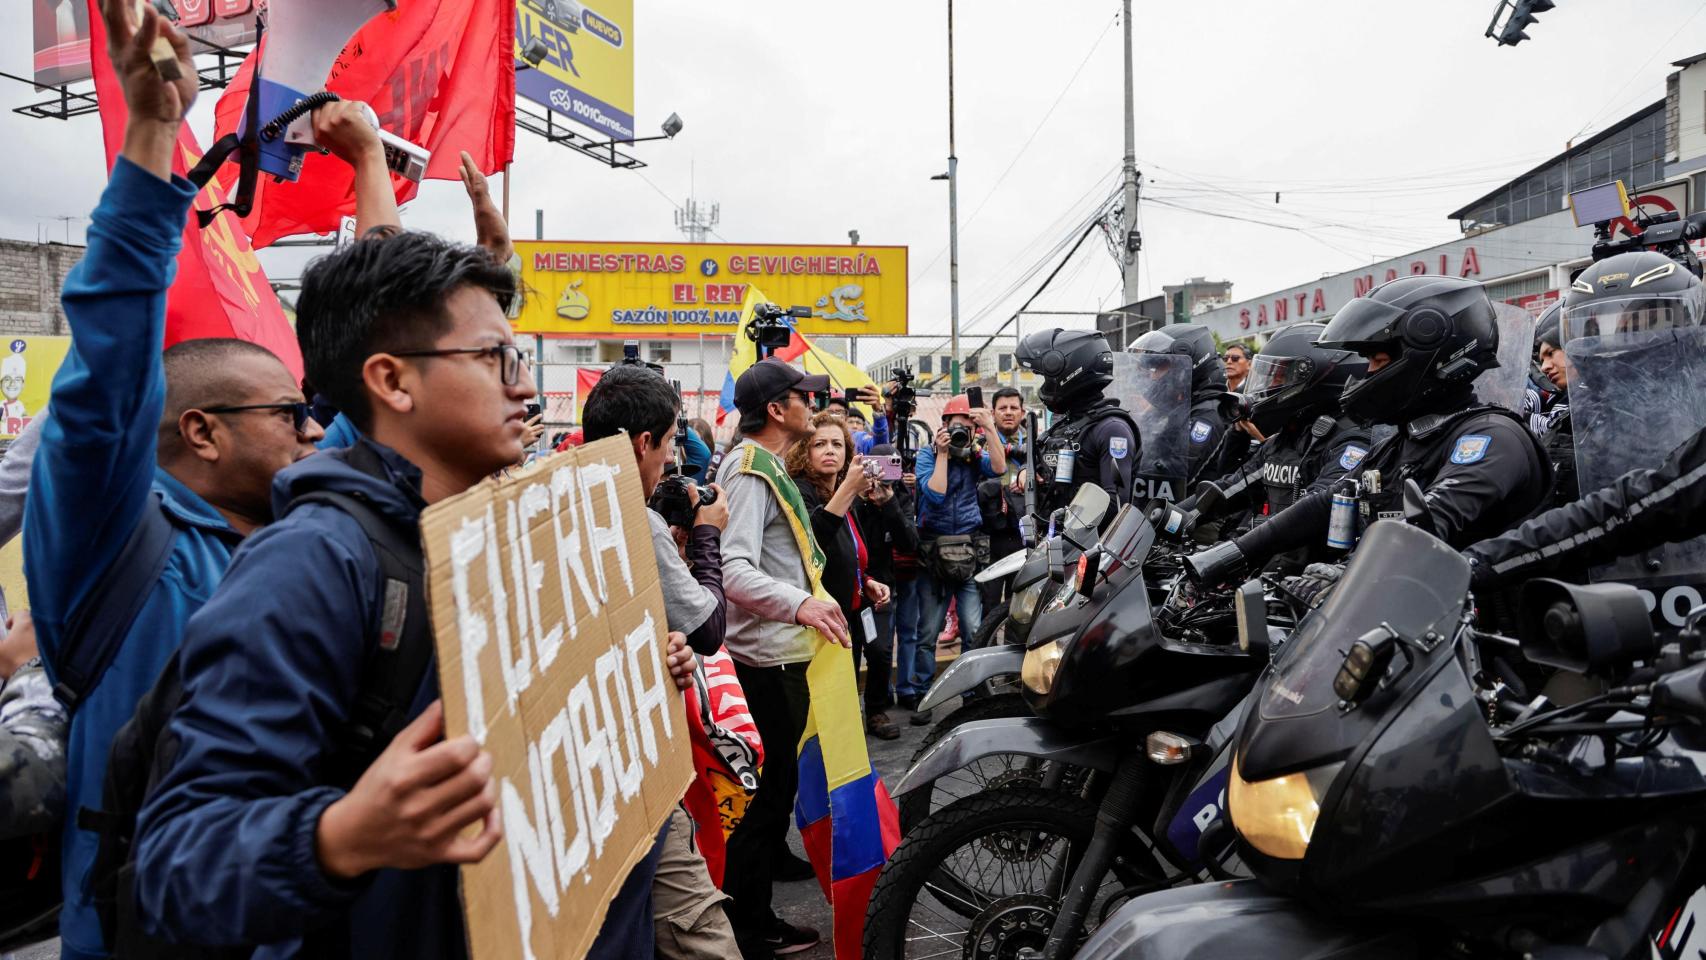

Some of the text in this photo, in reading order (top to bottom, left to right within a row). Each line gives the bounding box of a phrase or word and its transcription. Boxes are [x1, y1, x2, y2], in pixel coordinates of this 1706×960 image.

[534, 252, 686, 273] MENESTRAS
[728, 253, 881, 275] CEVICHERÍA
[673, 283, 746, 304] EL REY
[1239, 288, 1327, 329] SANTA
[611, 305, 668, 324] SAZÓN
[671, 309, 711, 324] 100%
[450, 458, 635, 745] FUERA
[500, 608, 674, 960] NOBOA
